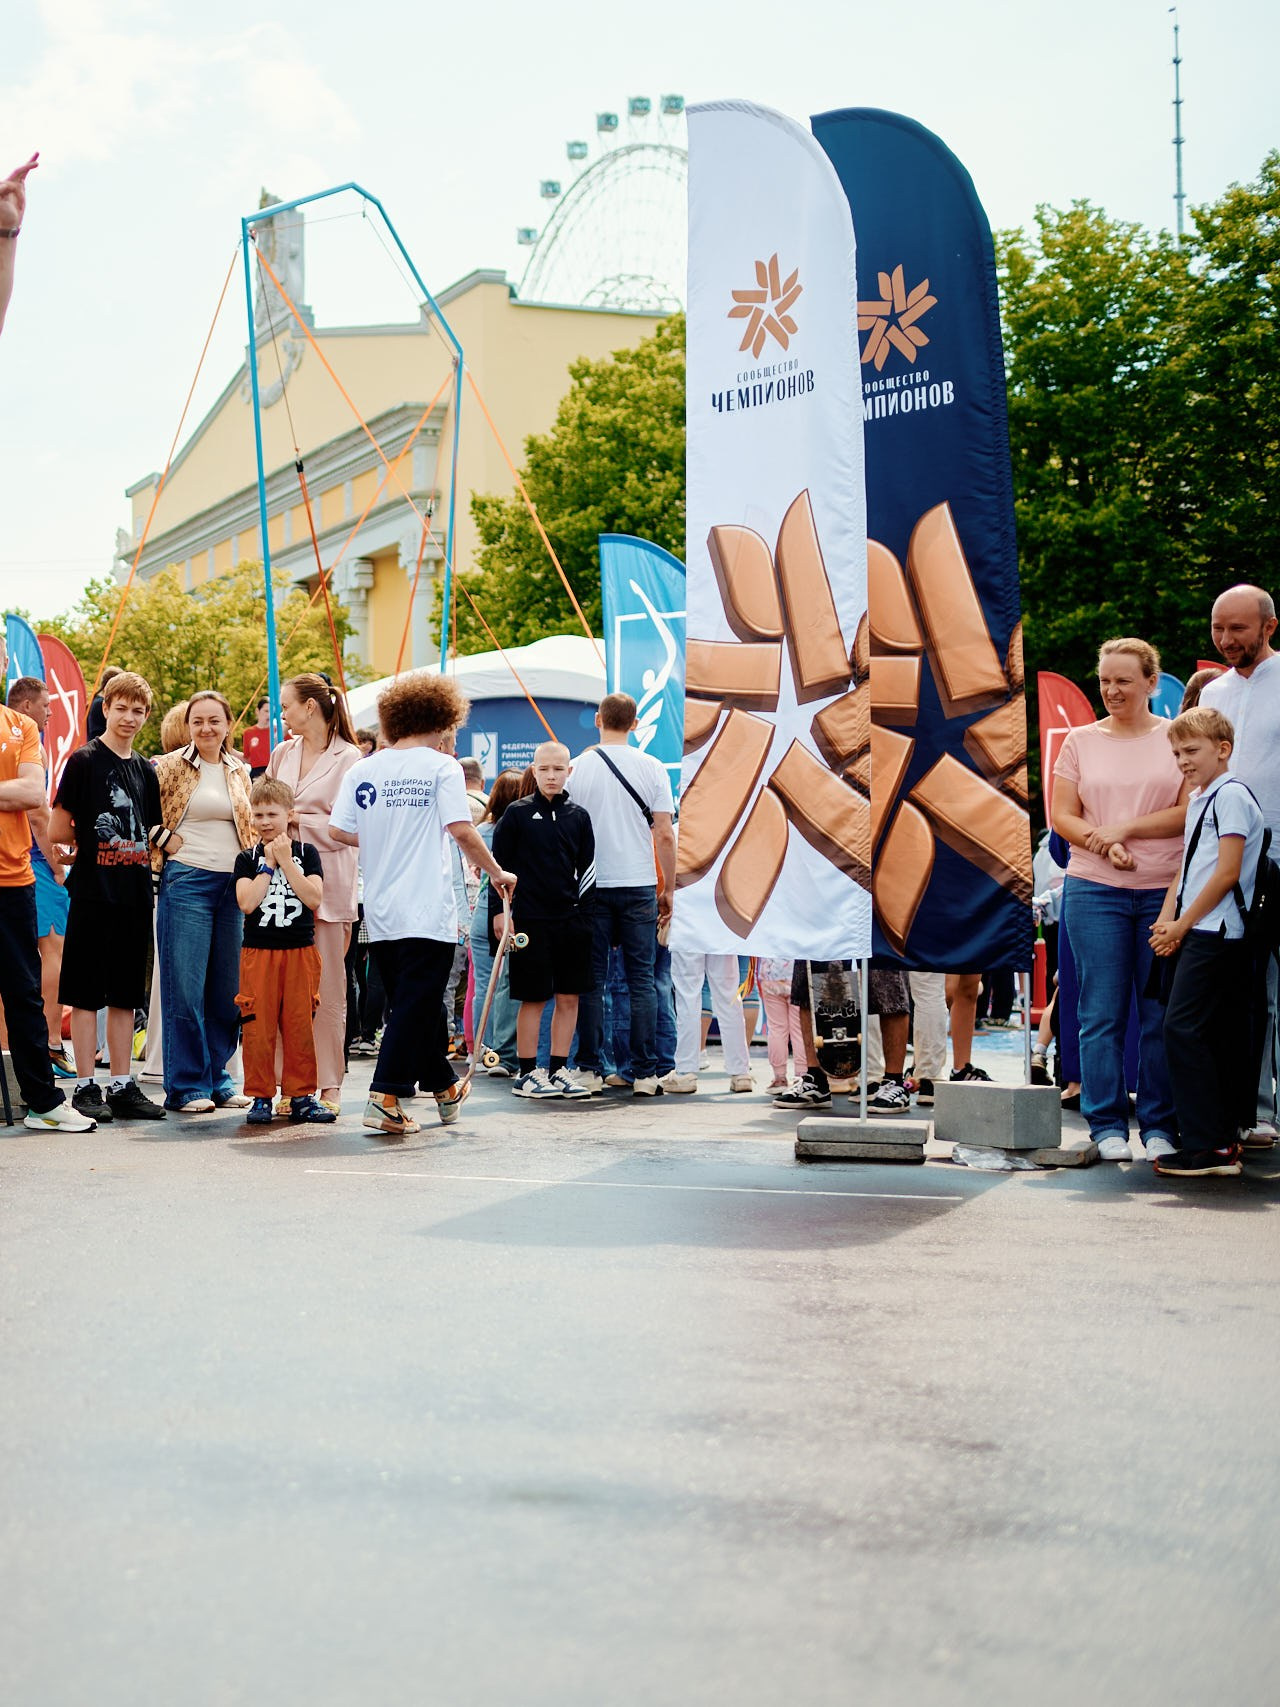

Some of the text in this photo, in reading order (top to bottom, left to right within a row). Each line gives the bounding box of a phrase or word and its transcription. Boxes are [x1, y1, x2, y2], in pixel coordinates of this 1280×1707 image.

[737, 359, 799, 383] СООБЩЕСТВО
[712, 370, 815, 413] ЧЕМПИОНОВ
[391, 778, 433, 787] ВЫБИРАЮ
[381, 787, 431, 797] ЗДОРОВОЕ
[386, 797, 430, 808] БУДУЩЕЕ
[258, 894, 303, 928] Я?
